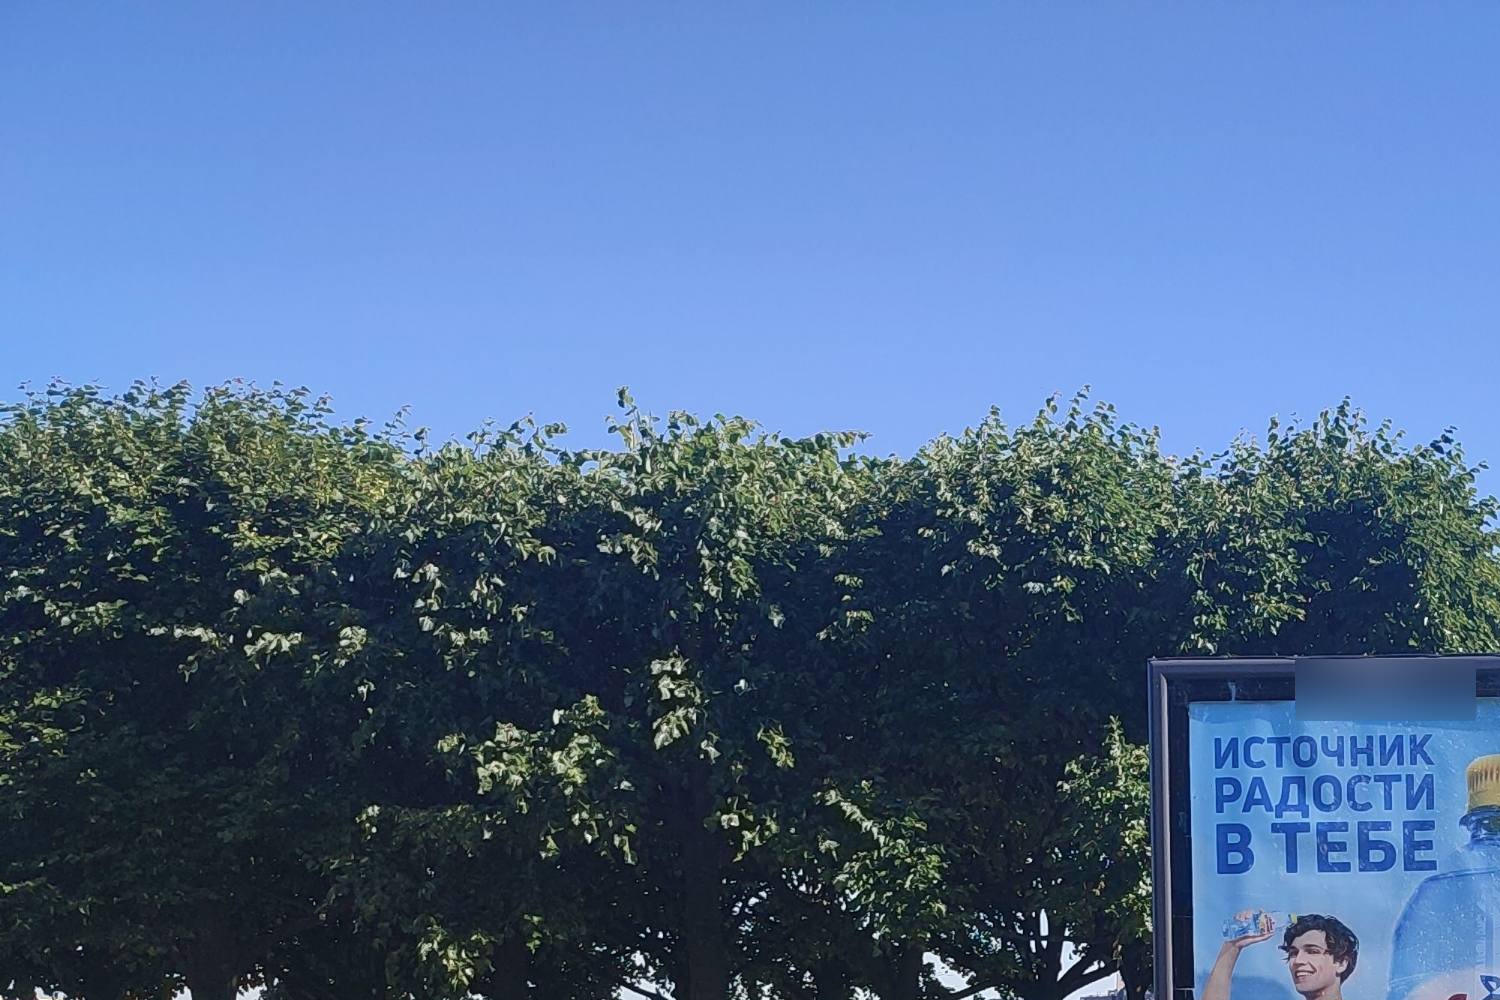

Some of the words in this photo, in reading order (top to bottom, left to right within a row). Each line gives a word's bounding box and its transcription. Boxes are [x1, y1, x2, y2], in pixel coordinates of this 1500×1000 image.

[1214, 734, 1435, 769] ИСТОЧНИК
[1215, 774, 1435, 819] РАДОСТИ
[1216, 823, 1255, 874] В
[1271, 820, 1438, 874] ТЕБЕ
